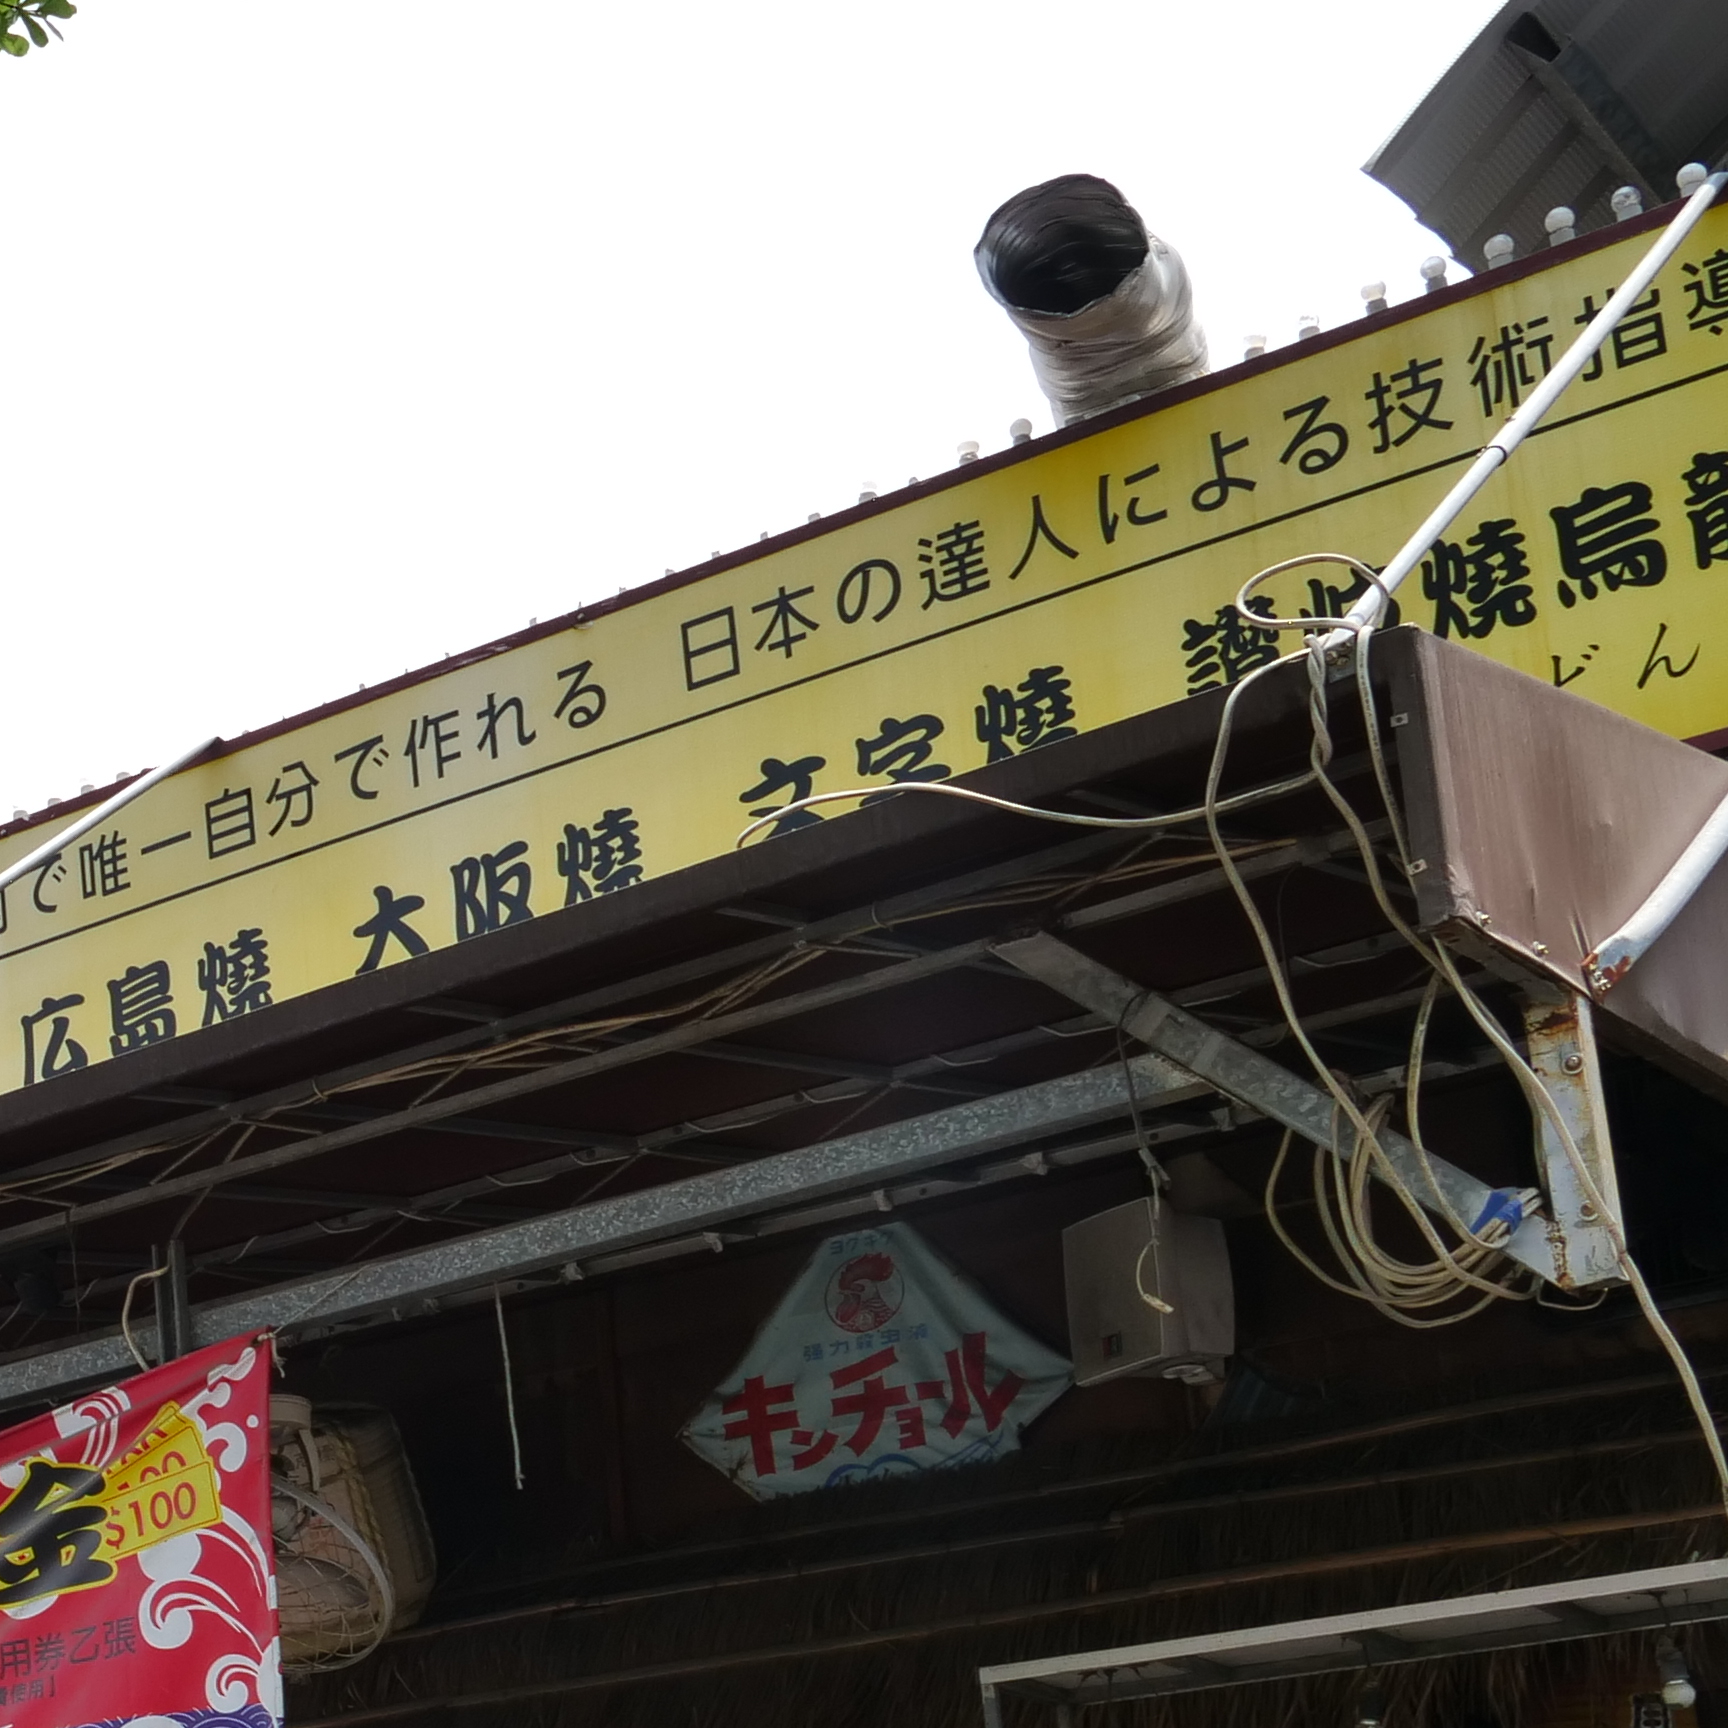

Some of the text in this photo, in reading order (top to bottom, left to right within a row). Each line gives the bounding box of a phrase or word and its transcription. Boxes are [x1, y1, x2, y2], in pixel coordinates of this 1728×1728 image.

[722, 1332, 1025, 1477] キンチョール
[105, 1480, 197, 1552] $100
